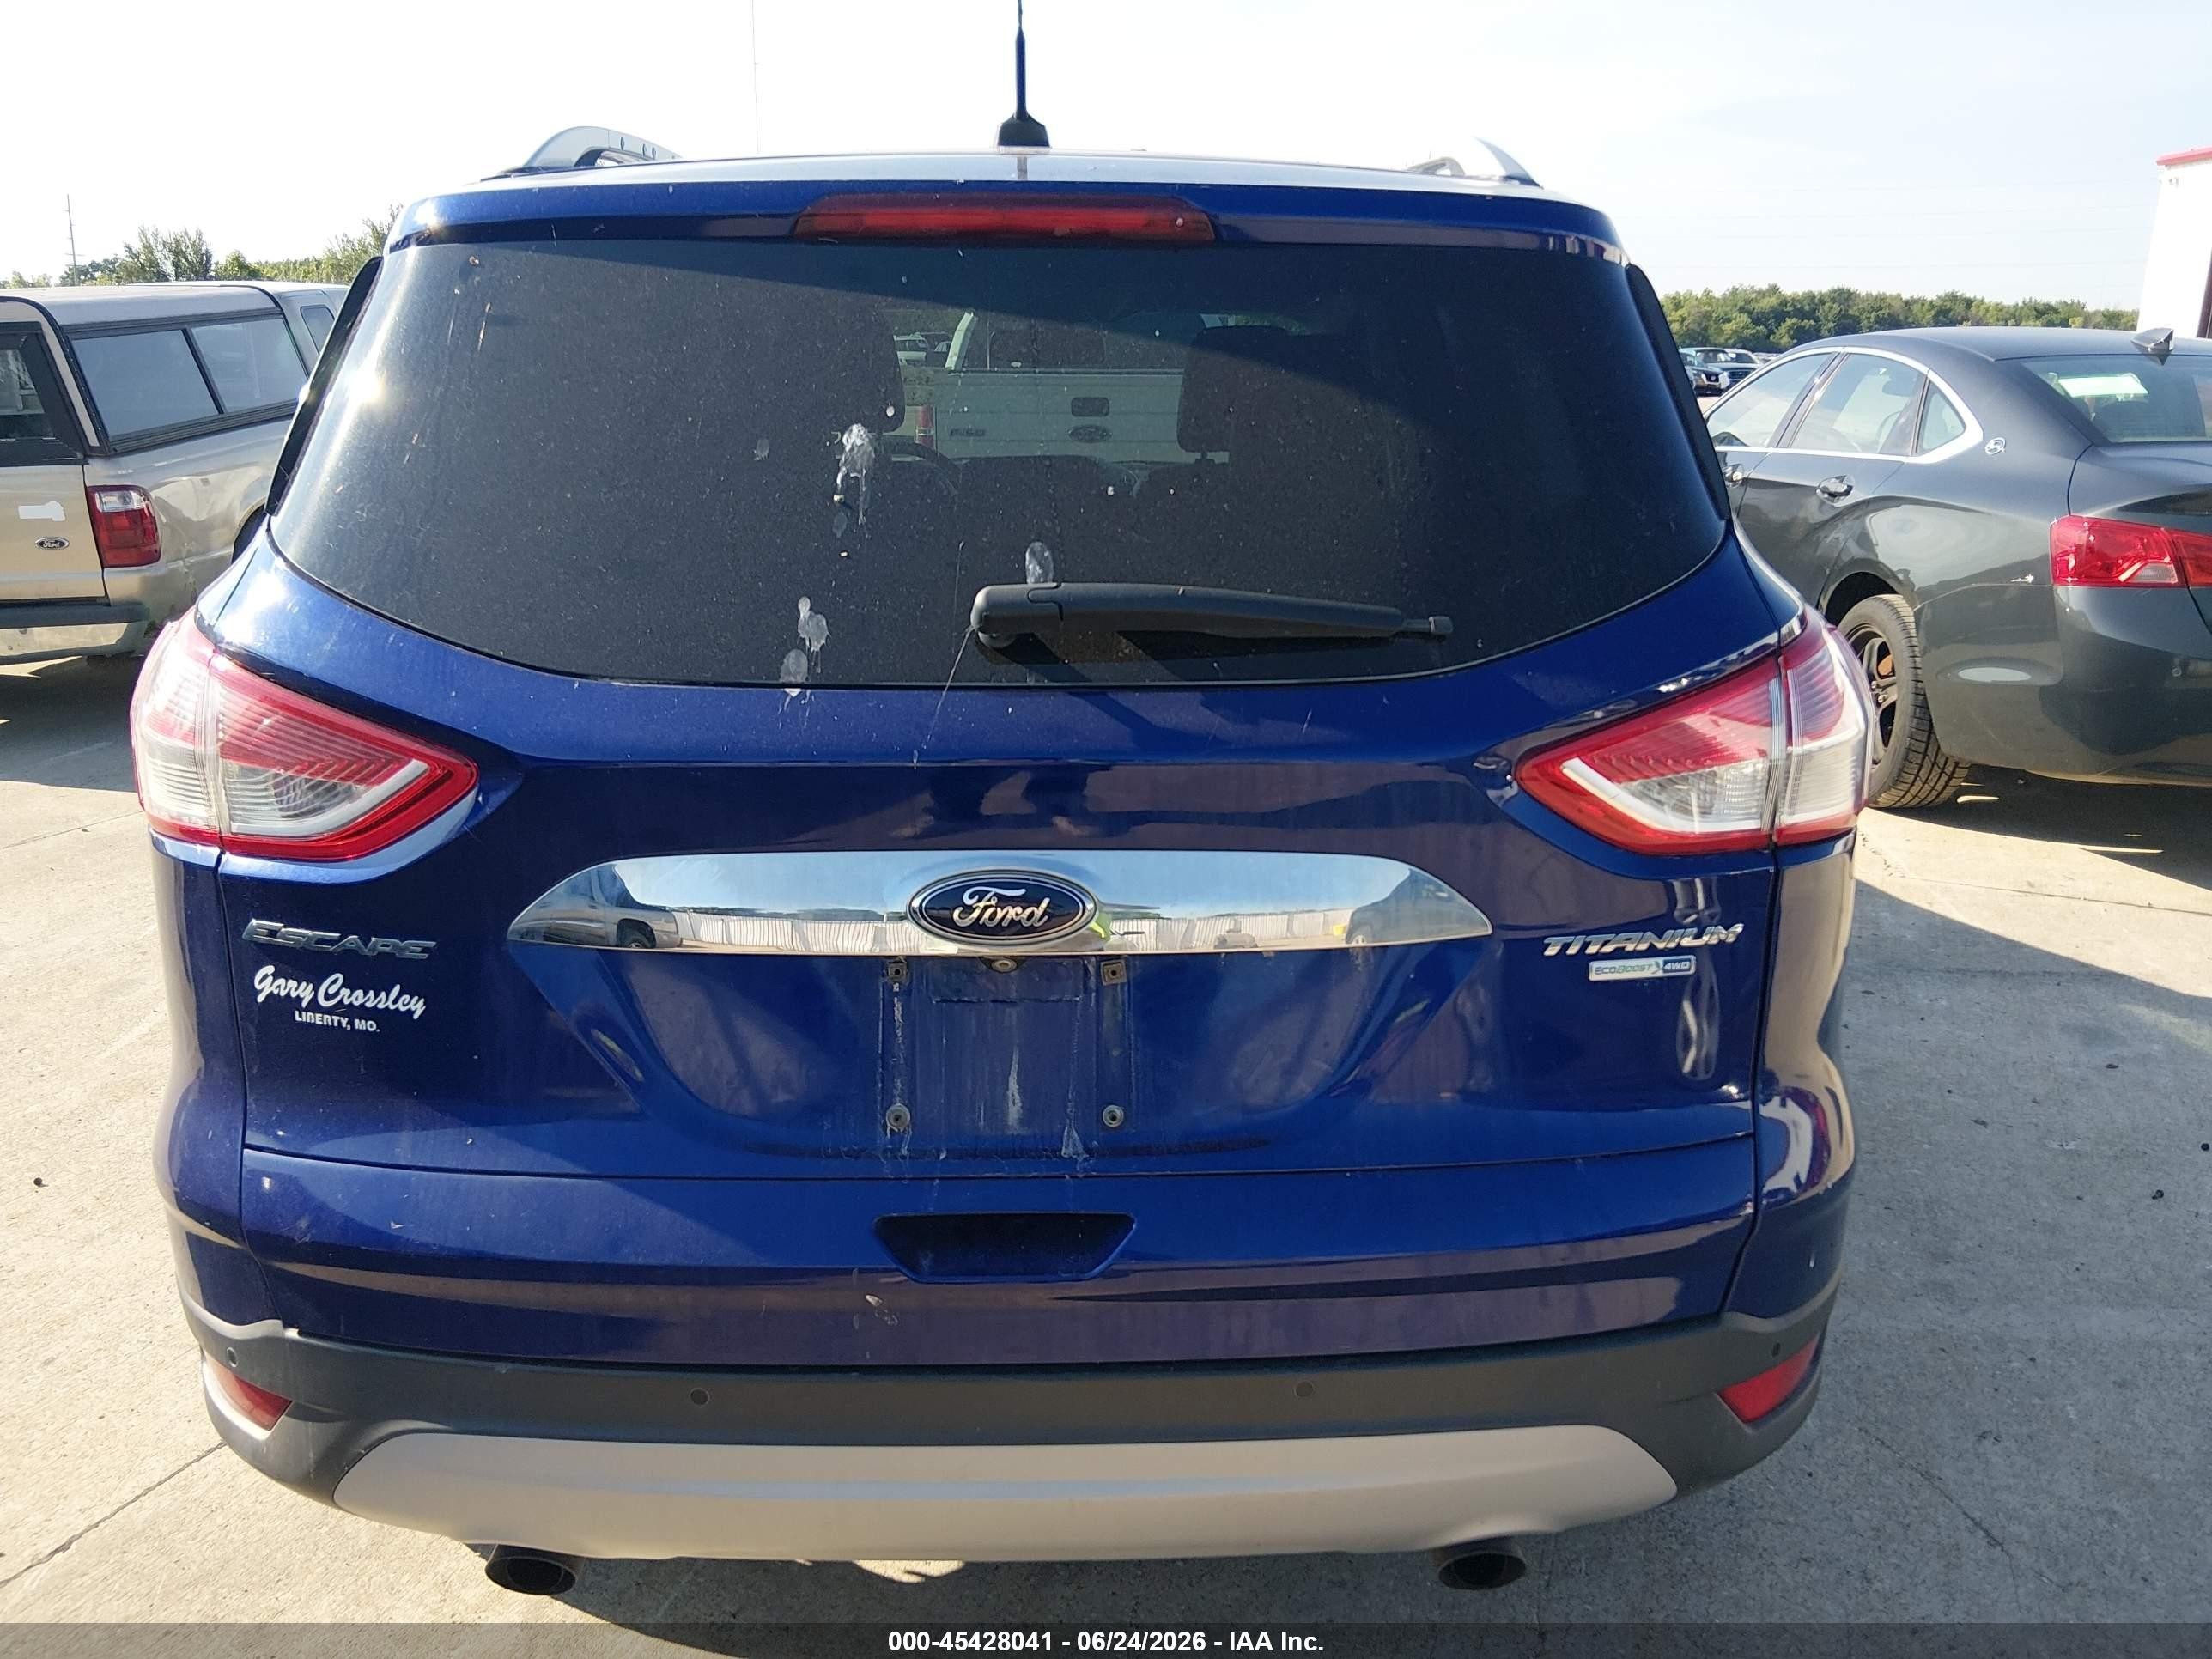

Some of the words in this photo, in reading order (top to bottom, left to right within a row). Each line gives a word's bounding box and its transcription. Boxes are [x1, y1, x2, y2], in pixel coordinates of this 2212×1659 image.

[952, 886, 1051, 927] Ford
[242, 918, 436, 959] ESCAPE
[1543, 923, 1744, 957] TITANIUM
[1663, 961, 1691, 971] 4WD
[254, 965, 314, 1007] Gary
[318, 973, 427, 1019] Crossley
[294, 1010, 351, 1031] LIBERTY,
[354, 1018, 380, 1032] MO.
